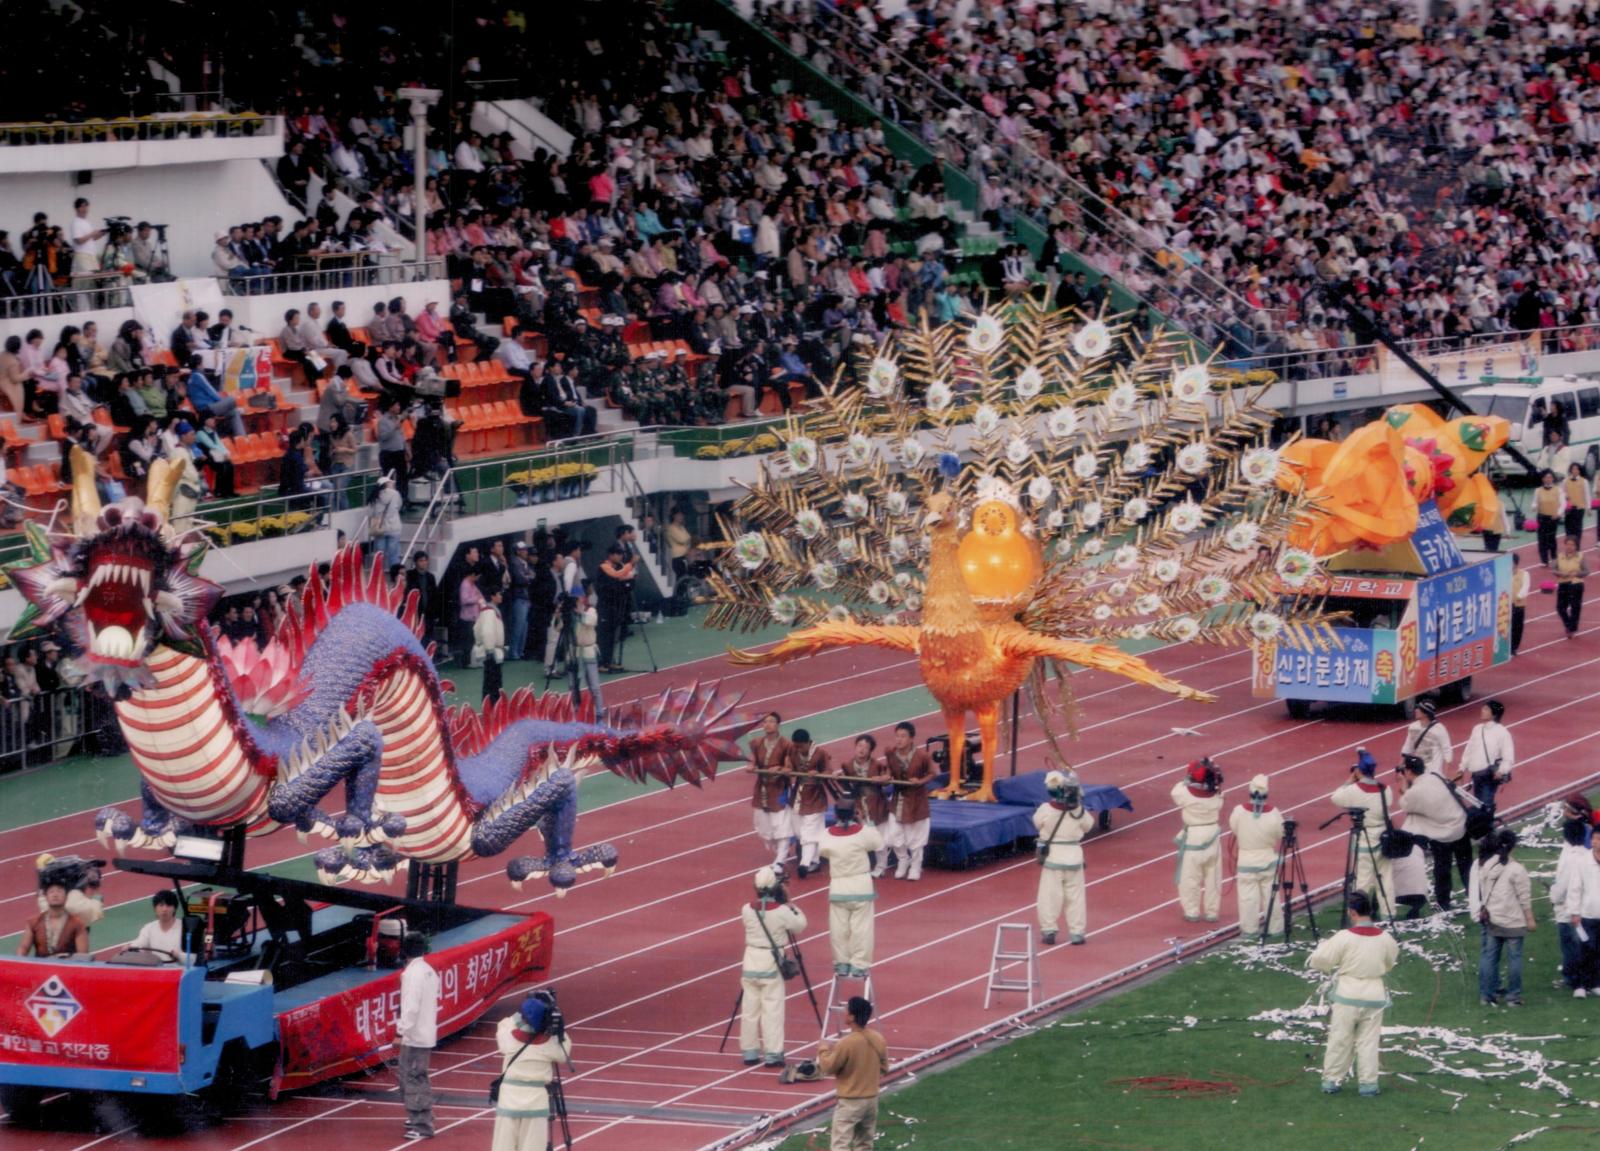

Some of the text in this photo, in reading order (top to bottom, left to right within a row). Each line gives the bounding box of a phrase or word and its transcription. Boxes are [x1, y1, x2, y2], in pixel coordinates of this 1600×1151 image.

[1319, 579, 1404, 595] 대학교
[1425, 590, 1493, 651] 신라문화제
[1278, 654, 1370, 688] 신라문화제
[1376, 650, 1394, 683] 축
[465, 941, 509, 993] 최적지
[61, 1042, 111, 1061] 진각종
